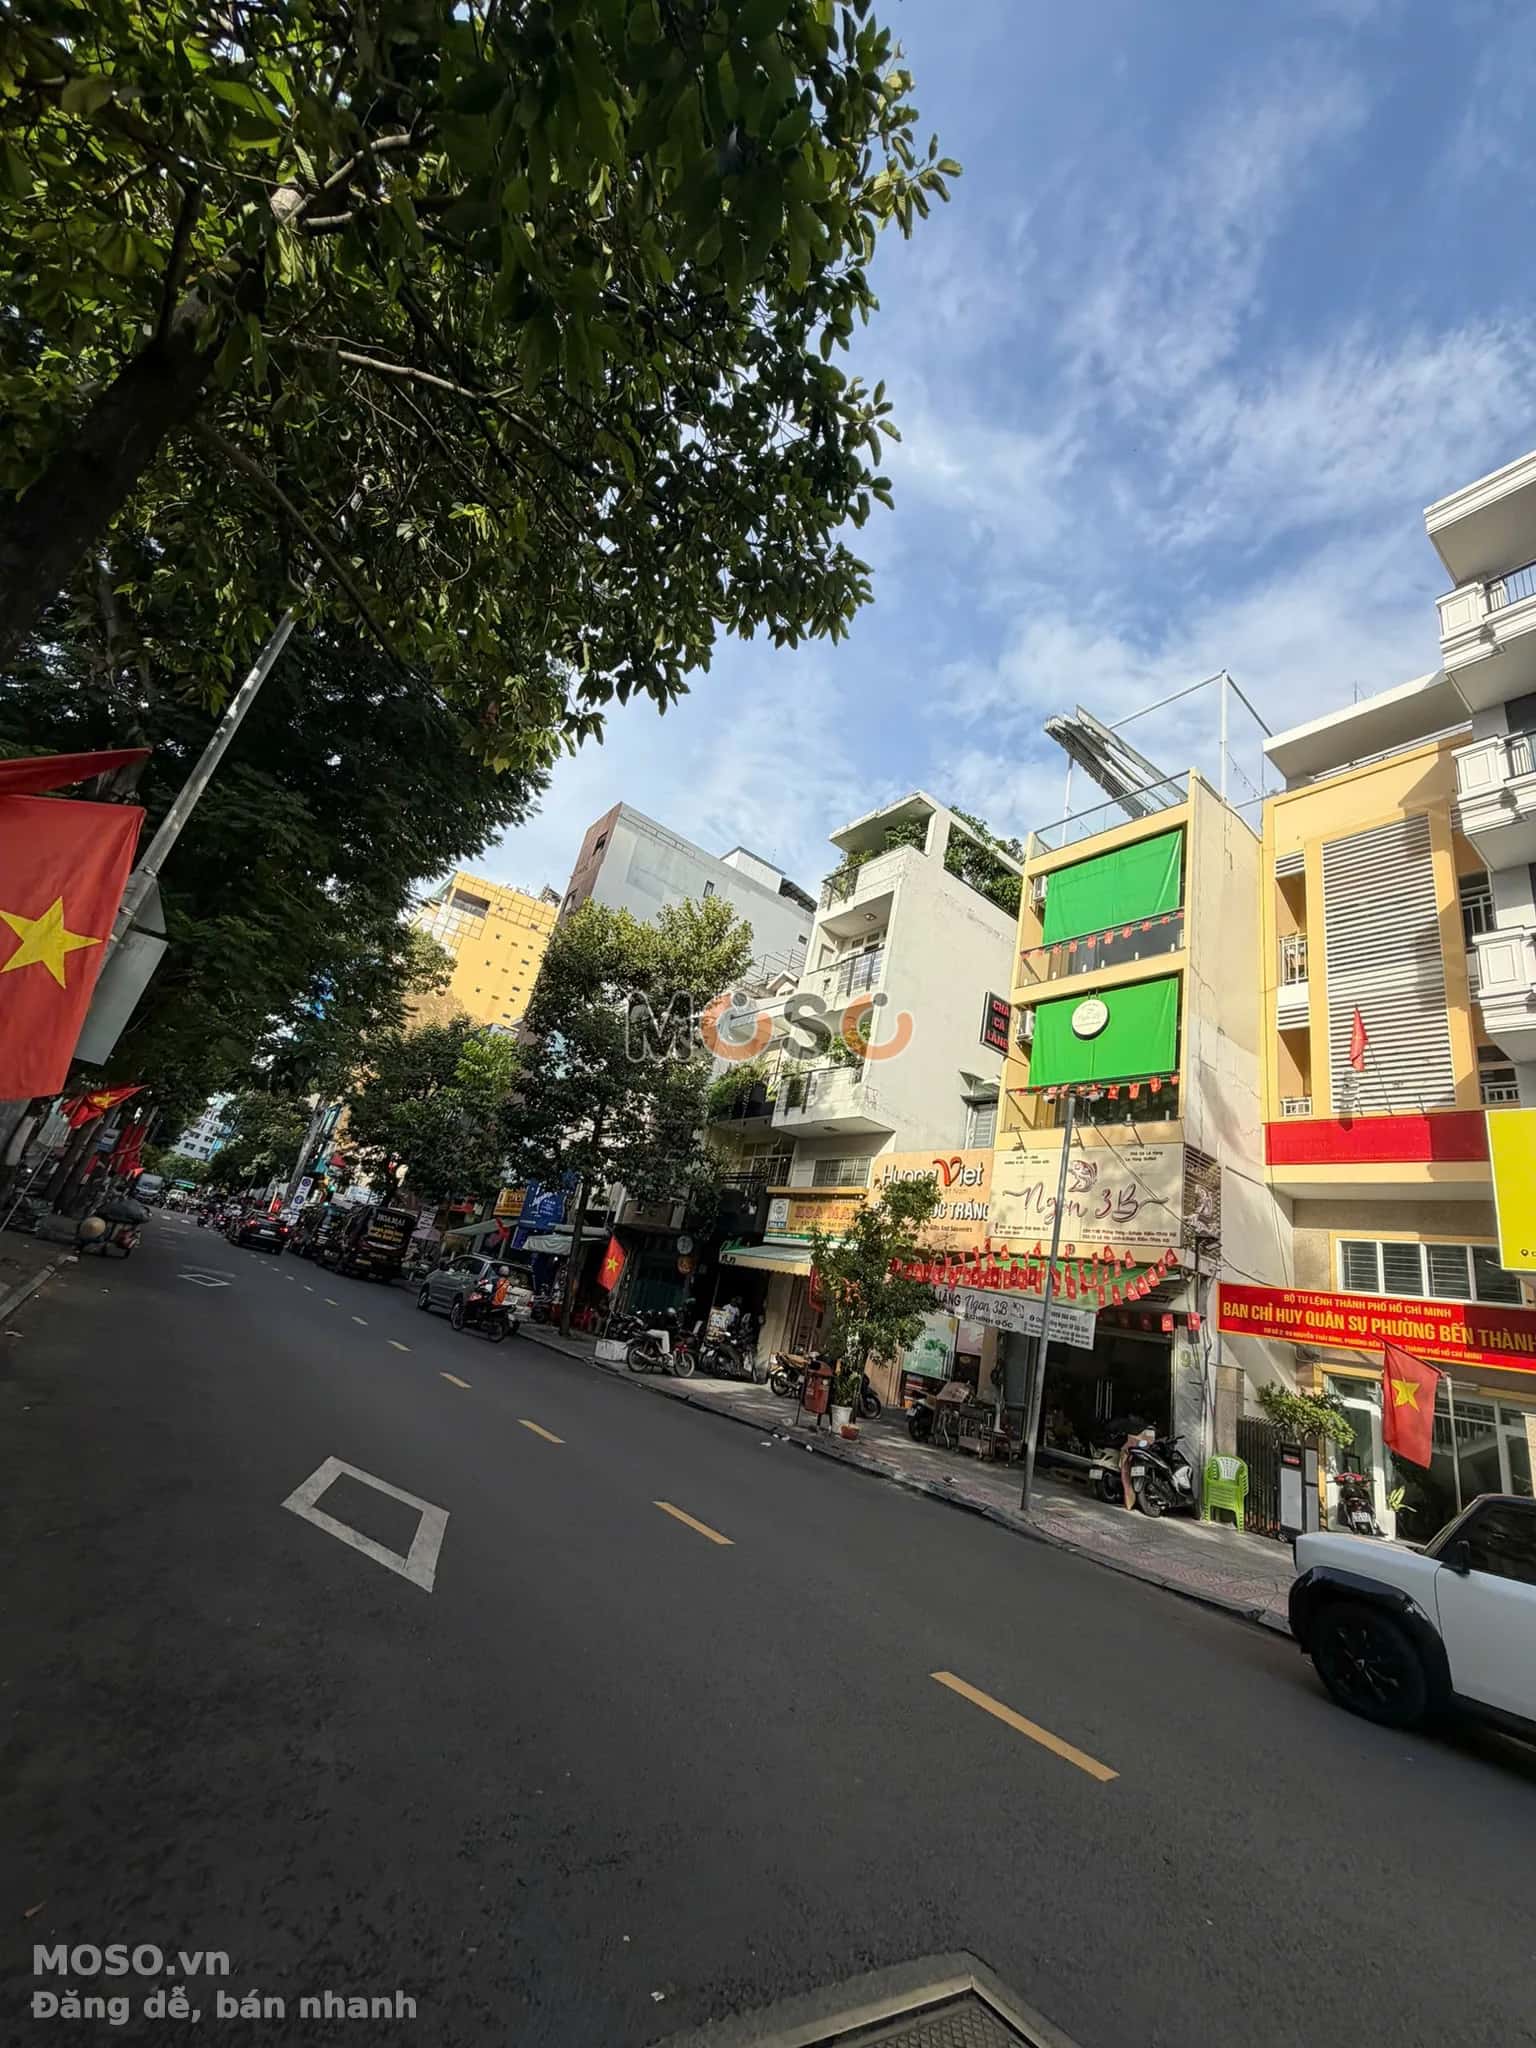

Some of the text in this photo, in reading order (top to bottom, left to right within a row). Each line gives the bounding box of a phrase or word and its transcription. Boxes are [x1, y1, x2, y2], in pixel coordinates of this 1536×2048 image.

[1223, 1302, 1249, 1319] BAN
[1251, 1301, 1273, 1322] CHỈ
[1275, 1308, 1303, 1325] HUY
[1305, 1310, 1345, 1330] QUÂN
[1371, 1317, 1436, 1340] PHƯỜNG
[1439, 1322, 1475, 1345] BẾN
[1284, 1294, 1296, 1305] BỘ
[1309, 1295, 1333, 1307] LỆNH
[1367, 1300, 1387, 1312] PHỐ
[1423, 1307, 1451, 1318] MINH
